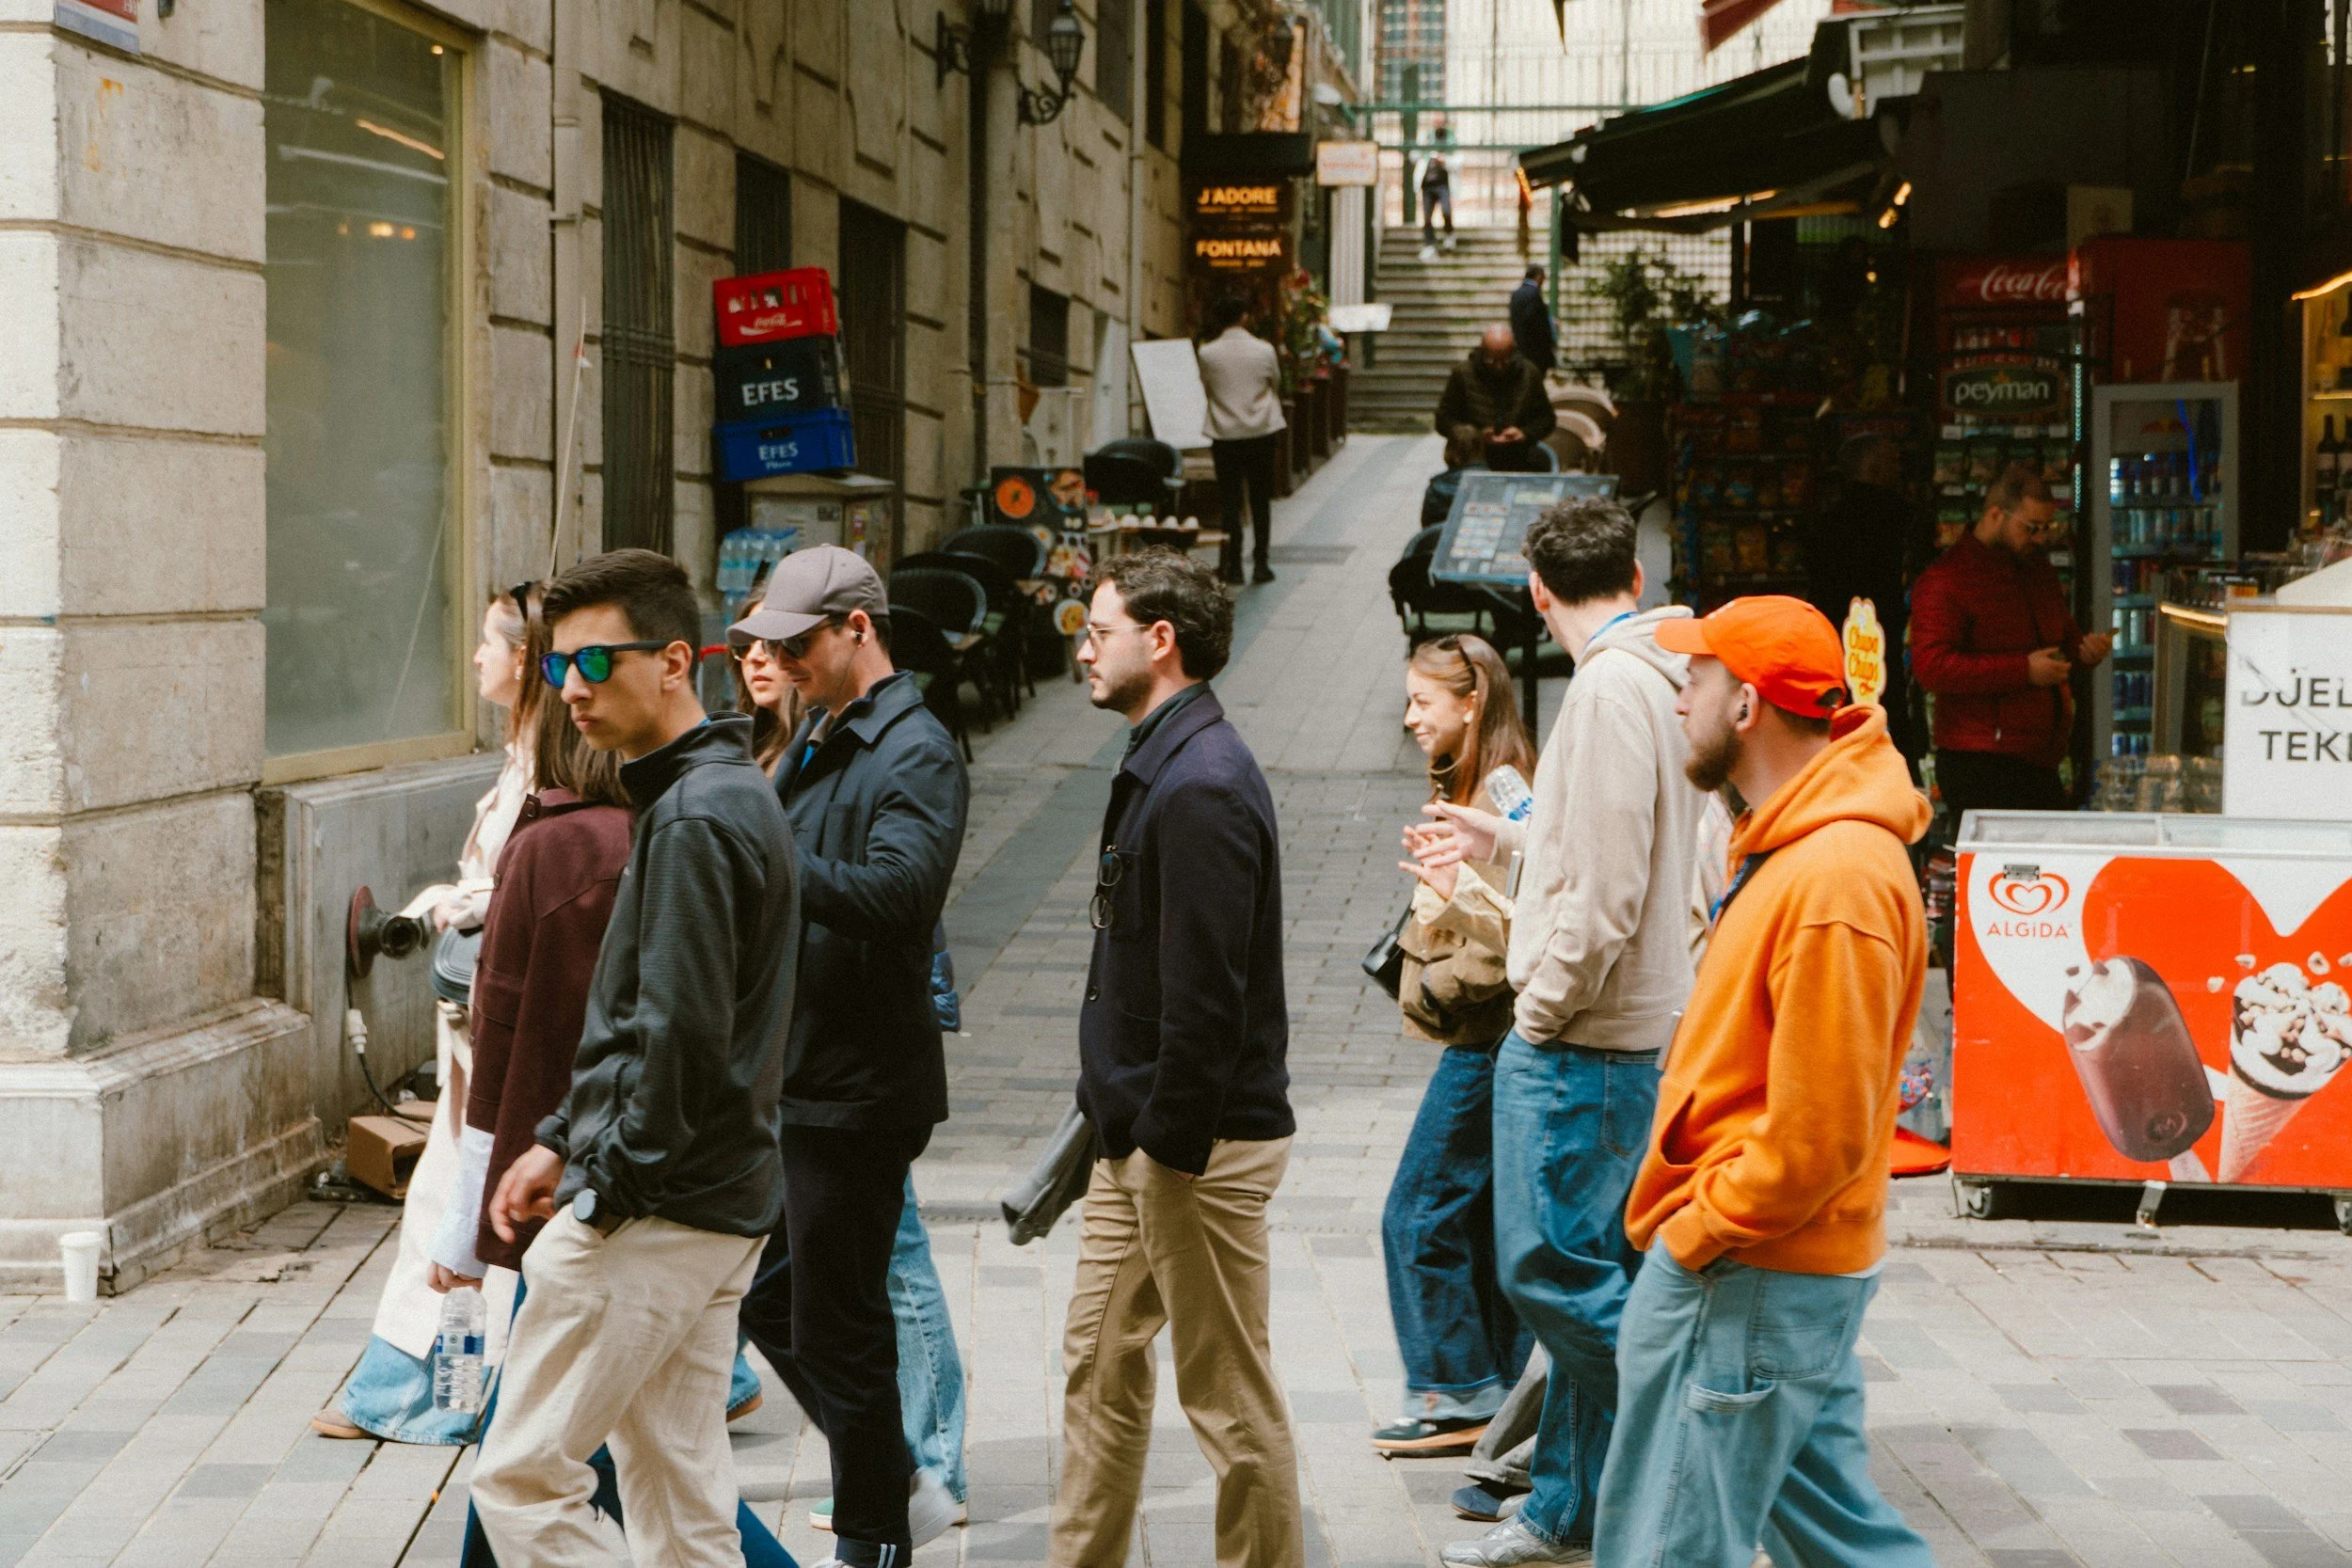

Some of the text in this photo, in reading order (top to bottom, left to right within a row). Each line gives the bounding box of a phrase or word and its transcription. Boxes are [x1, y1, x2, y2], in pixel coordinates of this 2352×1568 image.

[1195, 240, 1282, 258] FONTANA
[741, 378, 800, 406] EFES
[1955, 381, 2050, 405] peyman
[758, 442, 799, 461] EFES
